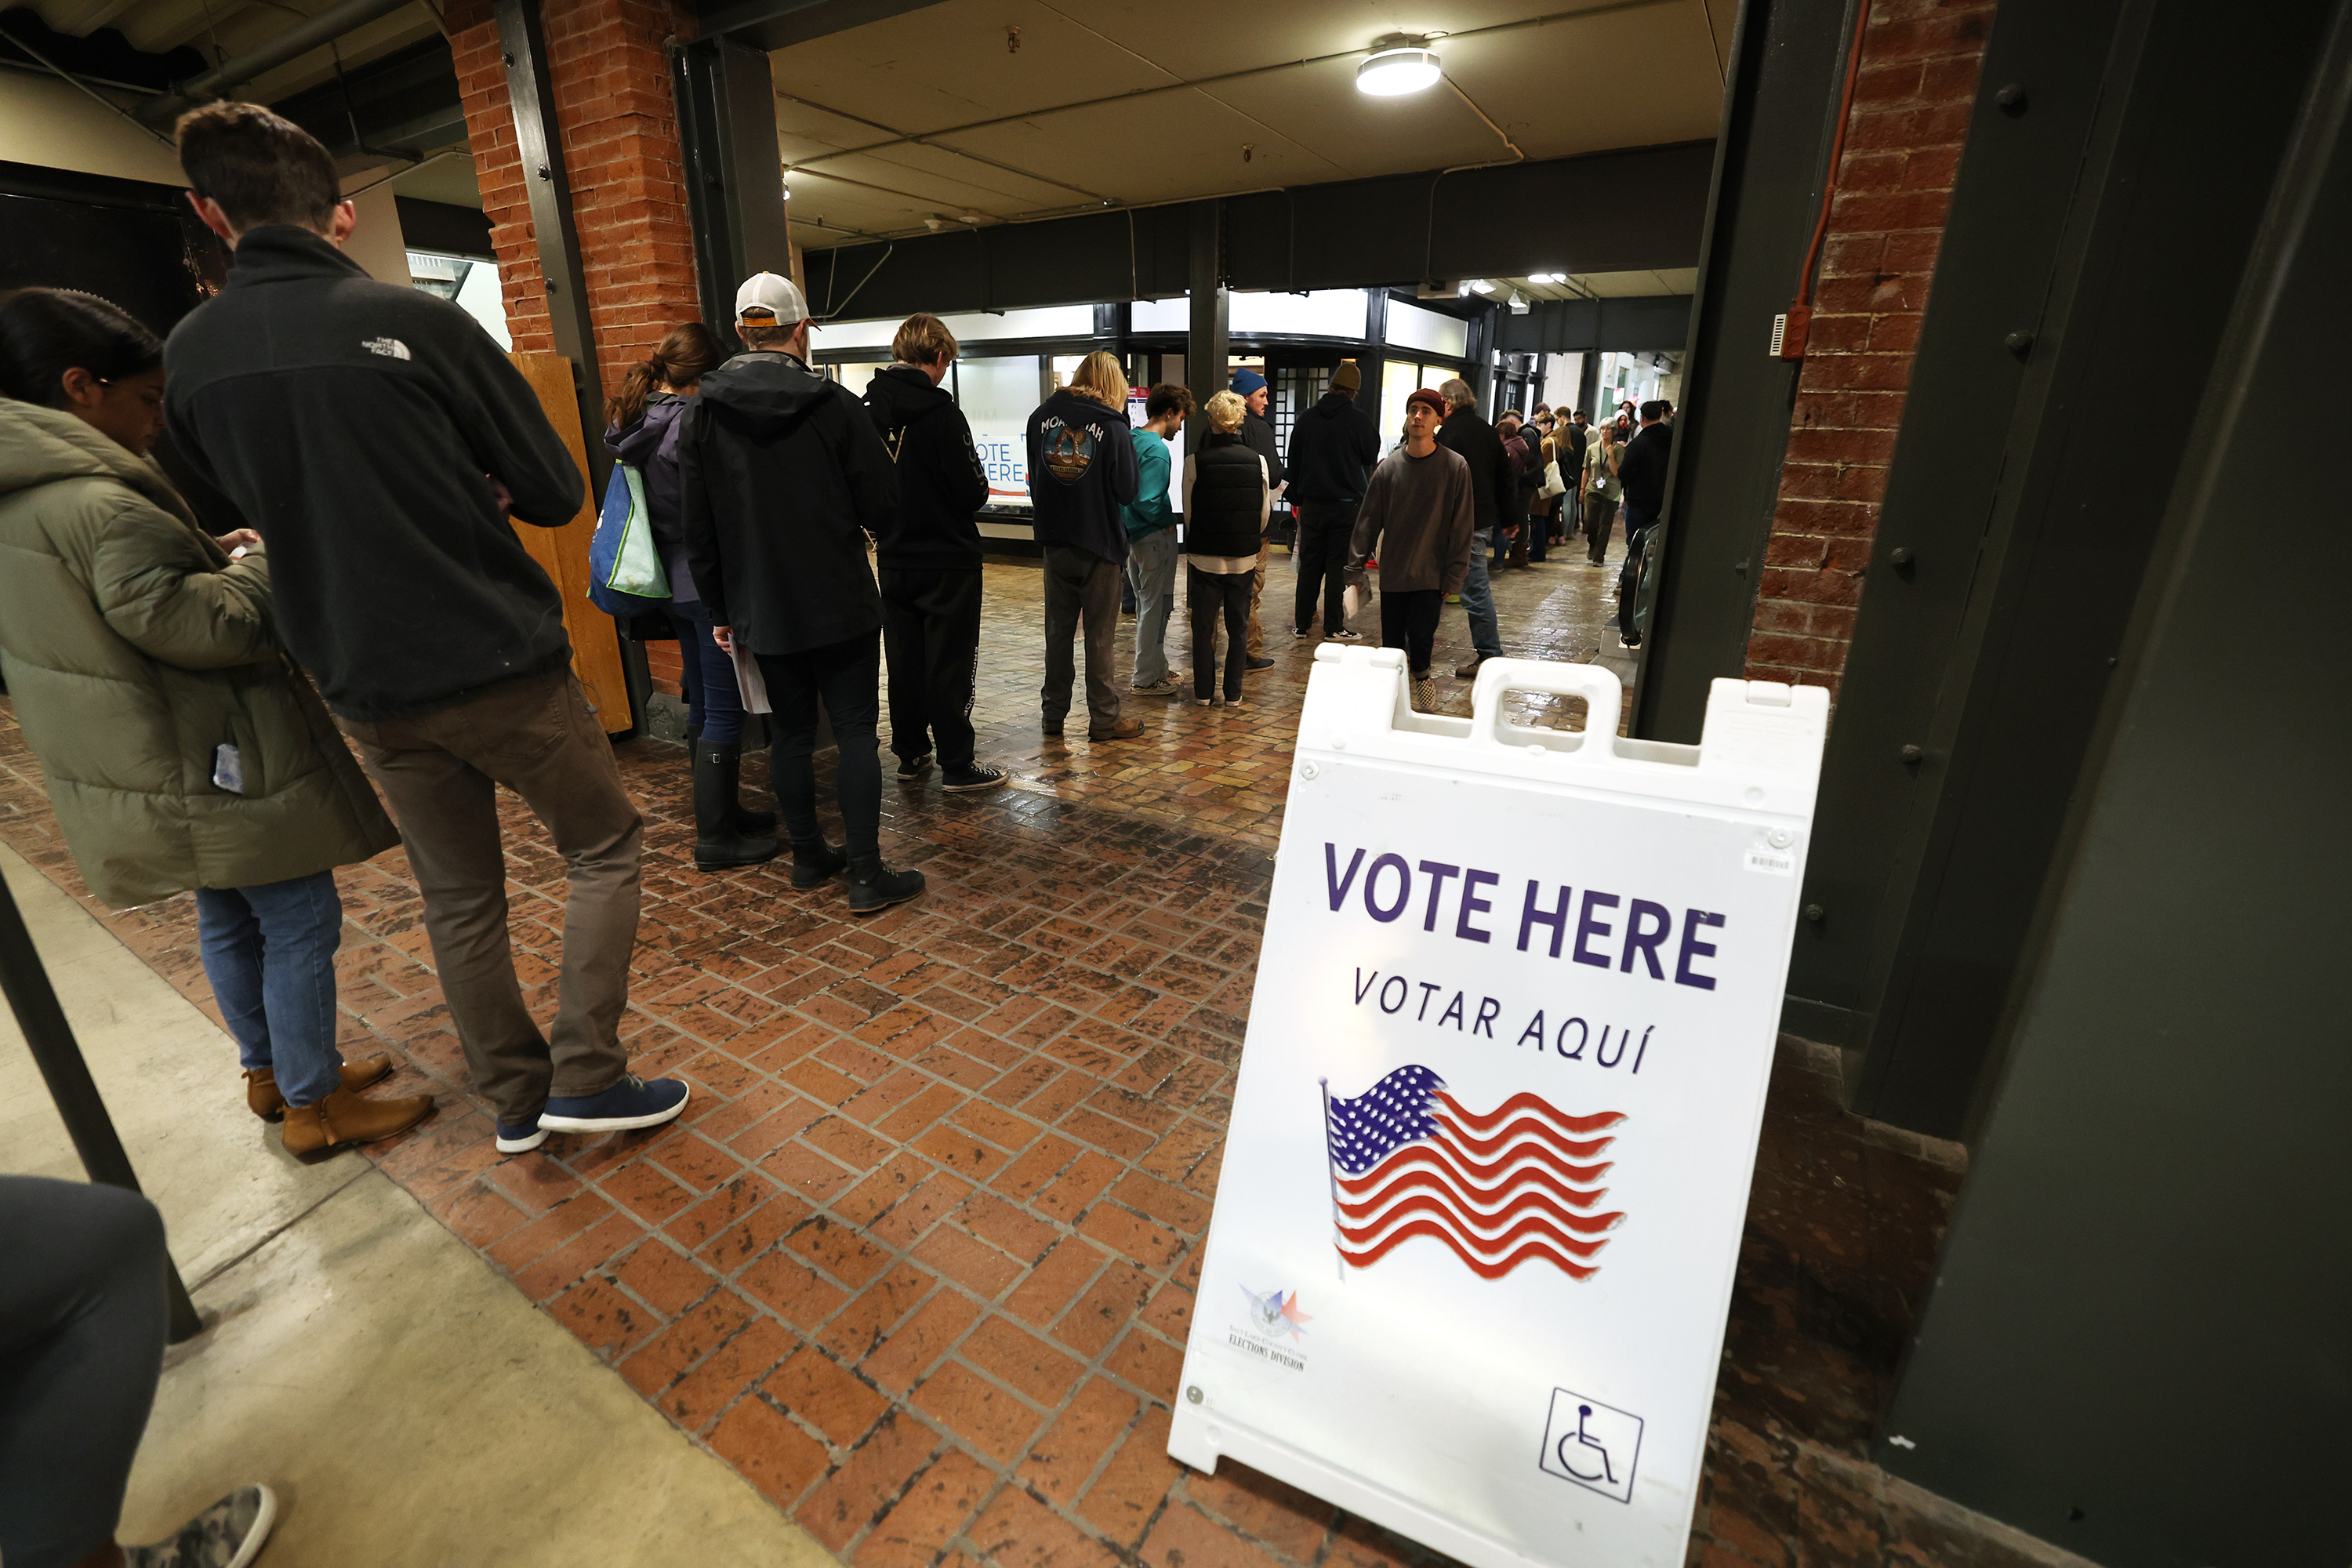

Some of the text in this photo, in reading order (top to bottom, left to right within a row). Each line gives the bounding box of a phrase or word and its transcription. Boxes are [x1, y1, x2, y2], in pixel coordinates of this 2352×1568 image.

[361, 340, 394, 350] NORTH
[1041, 416, 1068, 434] MOA
[975, 443, 1011, 462] OTE
[1324, 842, 1726, 991] VOTE HERE
[1355, 967, 1657, 1074] VOTAR AQUÍ
[1229, 1334, 1305, 1372] ELECTIONS DIVISION
